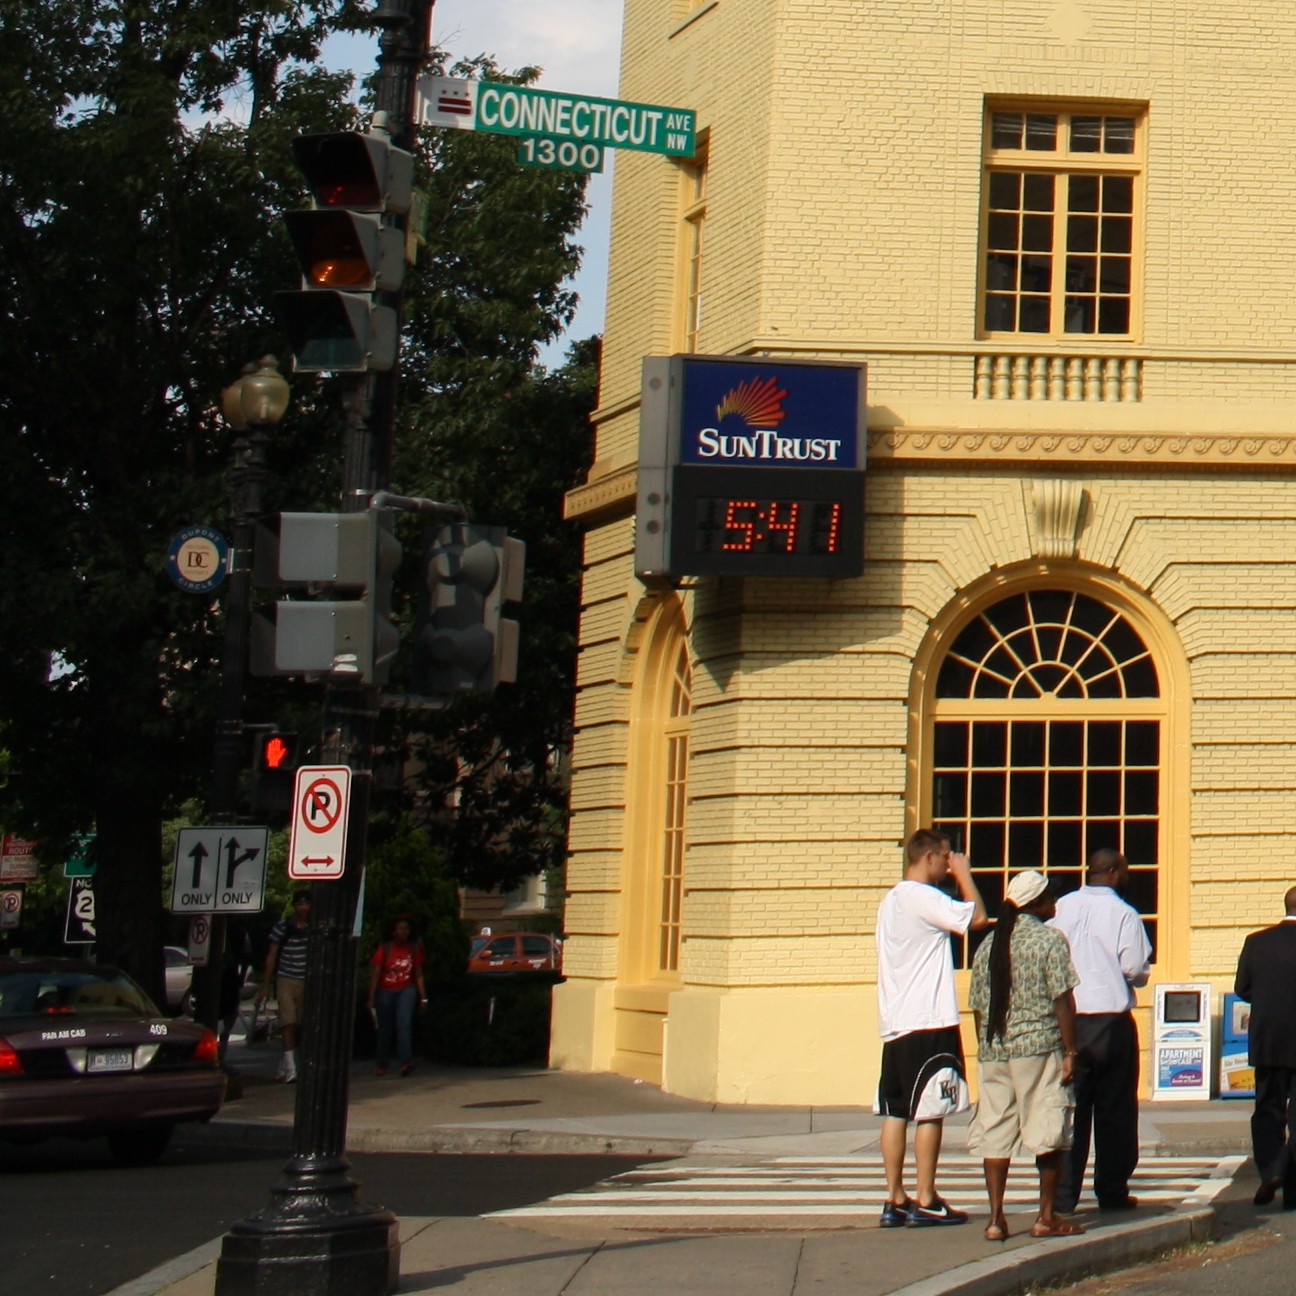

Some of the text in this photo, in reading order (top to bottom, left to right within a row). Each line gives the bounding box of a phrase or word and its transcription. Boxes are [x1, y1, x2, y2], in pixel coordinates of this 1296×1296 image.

[480, 88, 691, 146] CONNECTICUT AVE
[667, 134, 688, 151] NW
[523, 137, 600, 169] 1300
[699, 427, 841, 461] SUNTRUST
[722, 501, 842, 552] 5:41
[181, 529, 220, 542] DUPONT
[179, 577, 213, 590] CIRCLE
[181, 892, 253, 906] ONLY ONLY
[42, 1029, 86, 1041] PAN AM CAB
[150, 1024, 168, 1036] 409
[1160, 1048, 1202, 1060] APARTMENT
